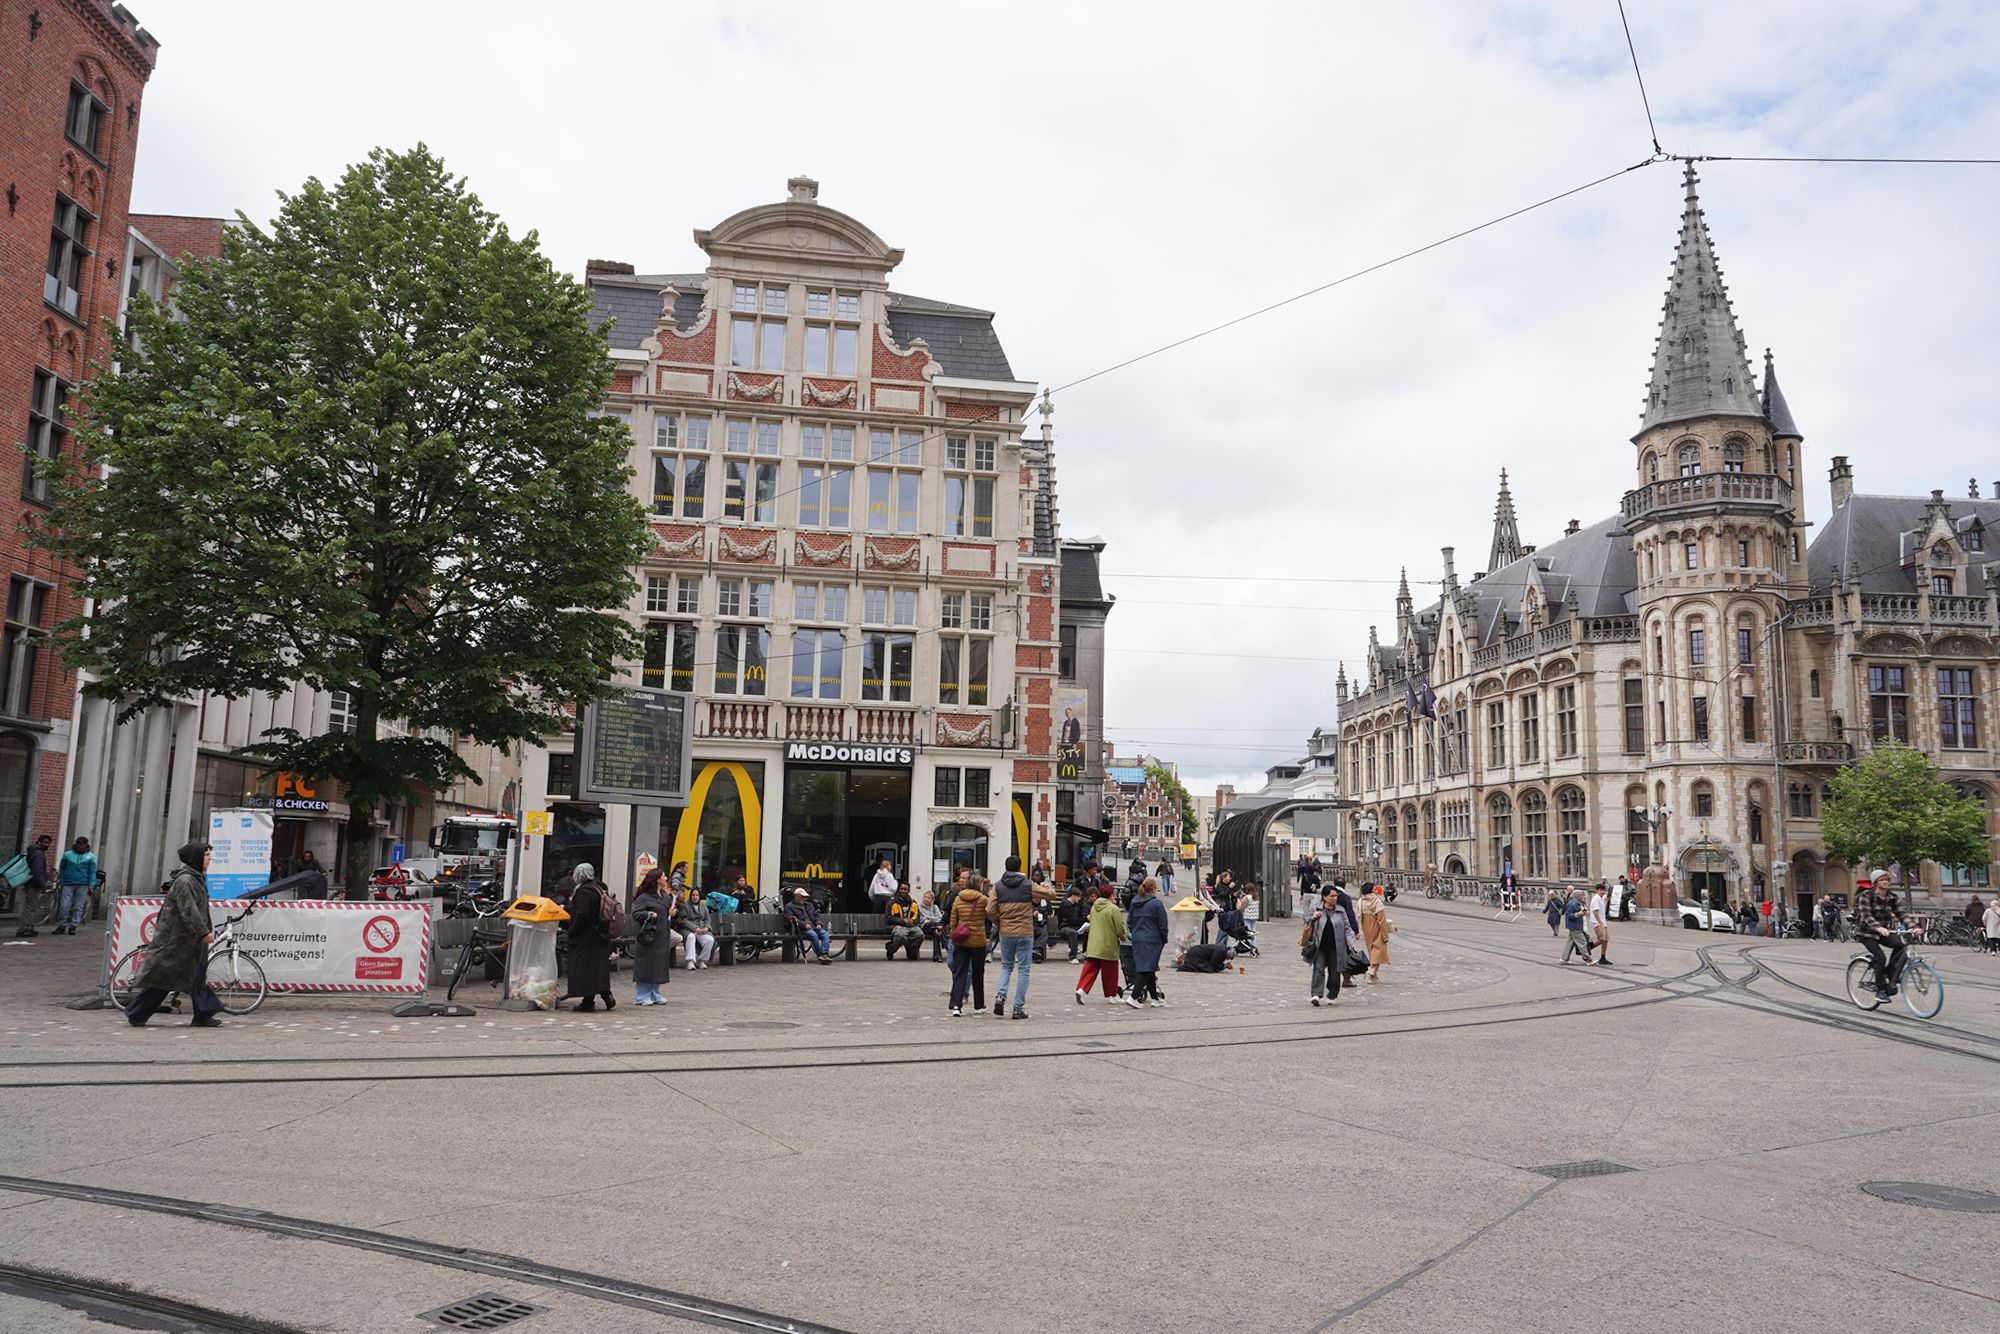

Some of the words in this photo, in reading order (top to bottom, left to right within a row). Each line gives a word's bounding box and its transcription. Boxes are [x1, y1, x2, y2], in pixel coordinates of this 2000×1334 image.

[788, 743, 912, 764] McDonald's
[284, 799, 330, 810] CHICKEN
[246, 948, 325, 960] rachtwagens!
